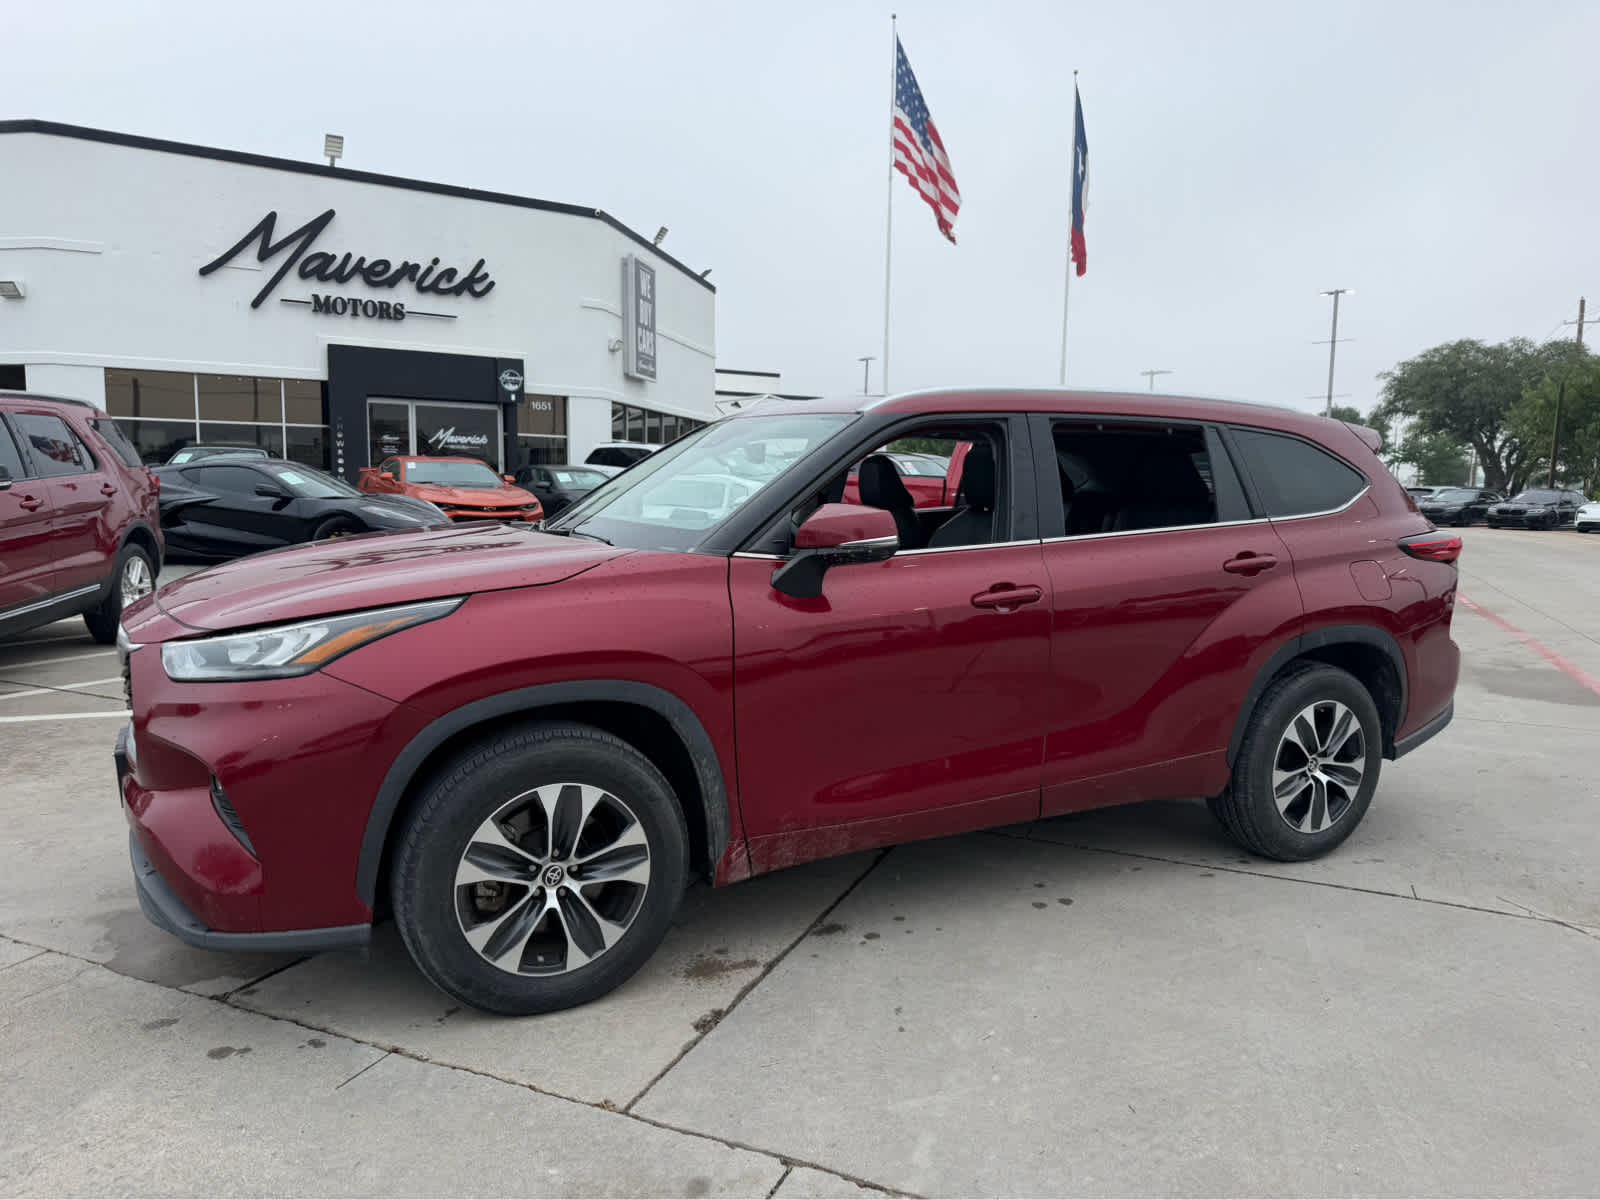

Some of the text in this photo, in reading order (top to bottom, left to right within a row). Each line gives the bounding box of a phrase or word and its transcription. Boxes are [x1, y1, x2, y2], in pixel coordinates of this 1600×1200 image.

[199, 209, 496, 309] Maverick
[312, 294, 406, 321] MOTORS
[532, 400, 552, 411] 1651
[428, 427, 488, 449] Maverick
